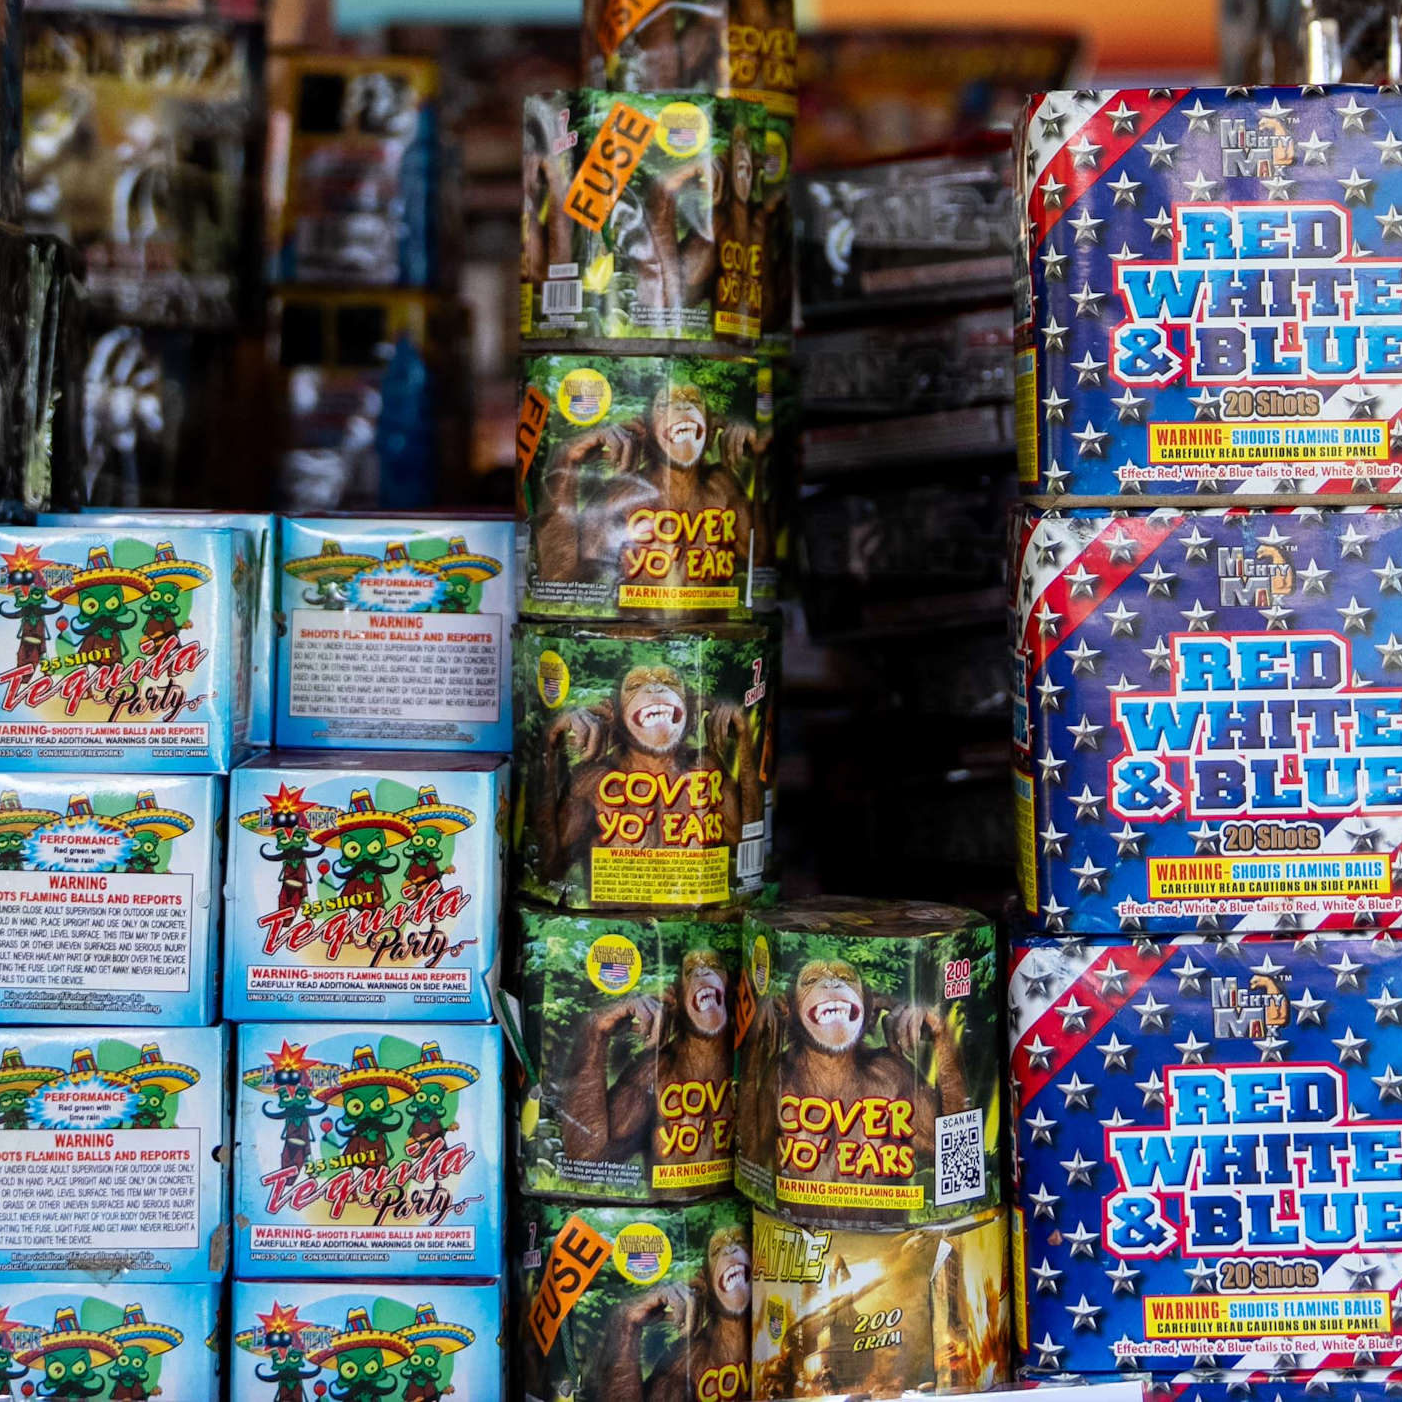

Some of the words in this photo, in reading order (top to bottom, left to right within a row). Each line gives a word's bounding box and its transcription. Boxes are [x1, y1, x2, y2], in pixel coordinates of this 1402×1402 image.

[570, 111, 651, 224] FUSE
[1179, 208, 1346, 262] RED
[1115, 324, 1180, 380] &
[627, 508, 736, 545] COVER
[627, 548, 681, 579] YO'
[687, 547, 735, 580] EARS
[40, 658, 60, 673] 25
[61, 647, 113, 670] SHOT
[752, 658, 763, 685] 7
[1177, 638, 1346, 693] RED
[106, 681, 200, 723] Party
[599, 770, 722, 807] COVER
[1114, 756, 1180, 813] &
[40, 835, 120, 845] PERFORMANCE
[599, 811, 654, 844] YO'
[663, 811, 722, 845] EARS
[1225, 825, 1252, 850] 20
[1257, 823, 1321, 850] Shots
[1161, 881, 1216, 893] CAREFULLY
[1219, 881, 1245, 893] READ
[1249, 881, 1301, 893] CAUTIONS
[1305, 881, 1318, 892] ON
[1321, 880, 1344, 892] SIDE
[1348, 879, 1378, 891] PANEL
[1232, 864, 1280, 879] SHOOTS
[1286, 863, 1340, 878] FLAMING
[1346, 862, 1382, 877] BALLS
[301, 902, 323, 916] 25
[325, 892, 373, 913] SHOT
[258, 881, 470, 961] Tequila
[368, 926, 462, 968] Party
[945, 958, 971, 982] 200
[945, 979, 971, 999] GRAM
[1211, 977, 1285, 1008] MIGHTY
[1213, 1006, 1280, 1038] MAX
[44, 1093, 126, 1102] PERFORMANCE
[1171, 1070, 1340, 1127] RED
[778, 1095, 913, 1137] COVER
[943, 1115, 964, 1127] SCAN
[965, 1113, 977, 1125] ME
[26, 1152, 74, 1161] FLAMING
[77, 1151, 110, 1161] BALLS
[114, 1151, 136, 1161] AND
[140, 1151, 190, 1160] REPORTS
[55, 1134, 114, 1147] WARNING
[305, 1160, 326, 1175] 25
[329, 1149, 378, 1172] SHOT
[777, 1139, 827, 1170] YO'
[836, 1141, 914, 1178] EARS
[262, 1139, 474, 1219] Tequila
[778, 1179, 826, 1195] WARNING
[827, 1184, 858, 1195] SHOOTS
[859, 1186, 891, 1197] FLAMING
[893, 1187, 919, 1198] BALLS
[372, 1186, 467, 1226] Party
[1110, 1192, 1176, 1250] &
[752, 1224, 830, 1284] ATTLE
[532, 1227, 603, 1339] FUSE
[1221, 1264, 1249, 1289] 20
[1253, 1261, 1319, 1289] Shots
[853, 1308, 902, 1334] 200
[853, 1330, 902, 1352] GRAM
